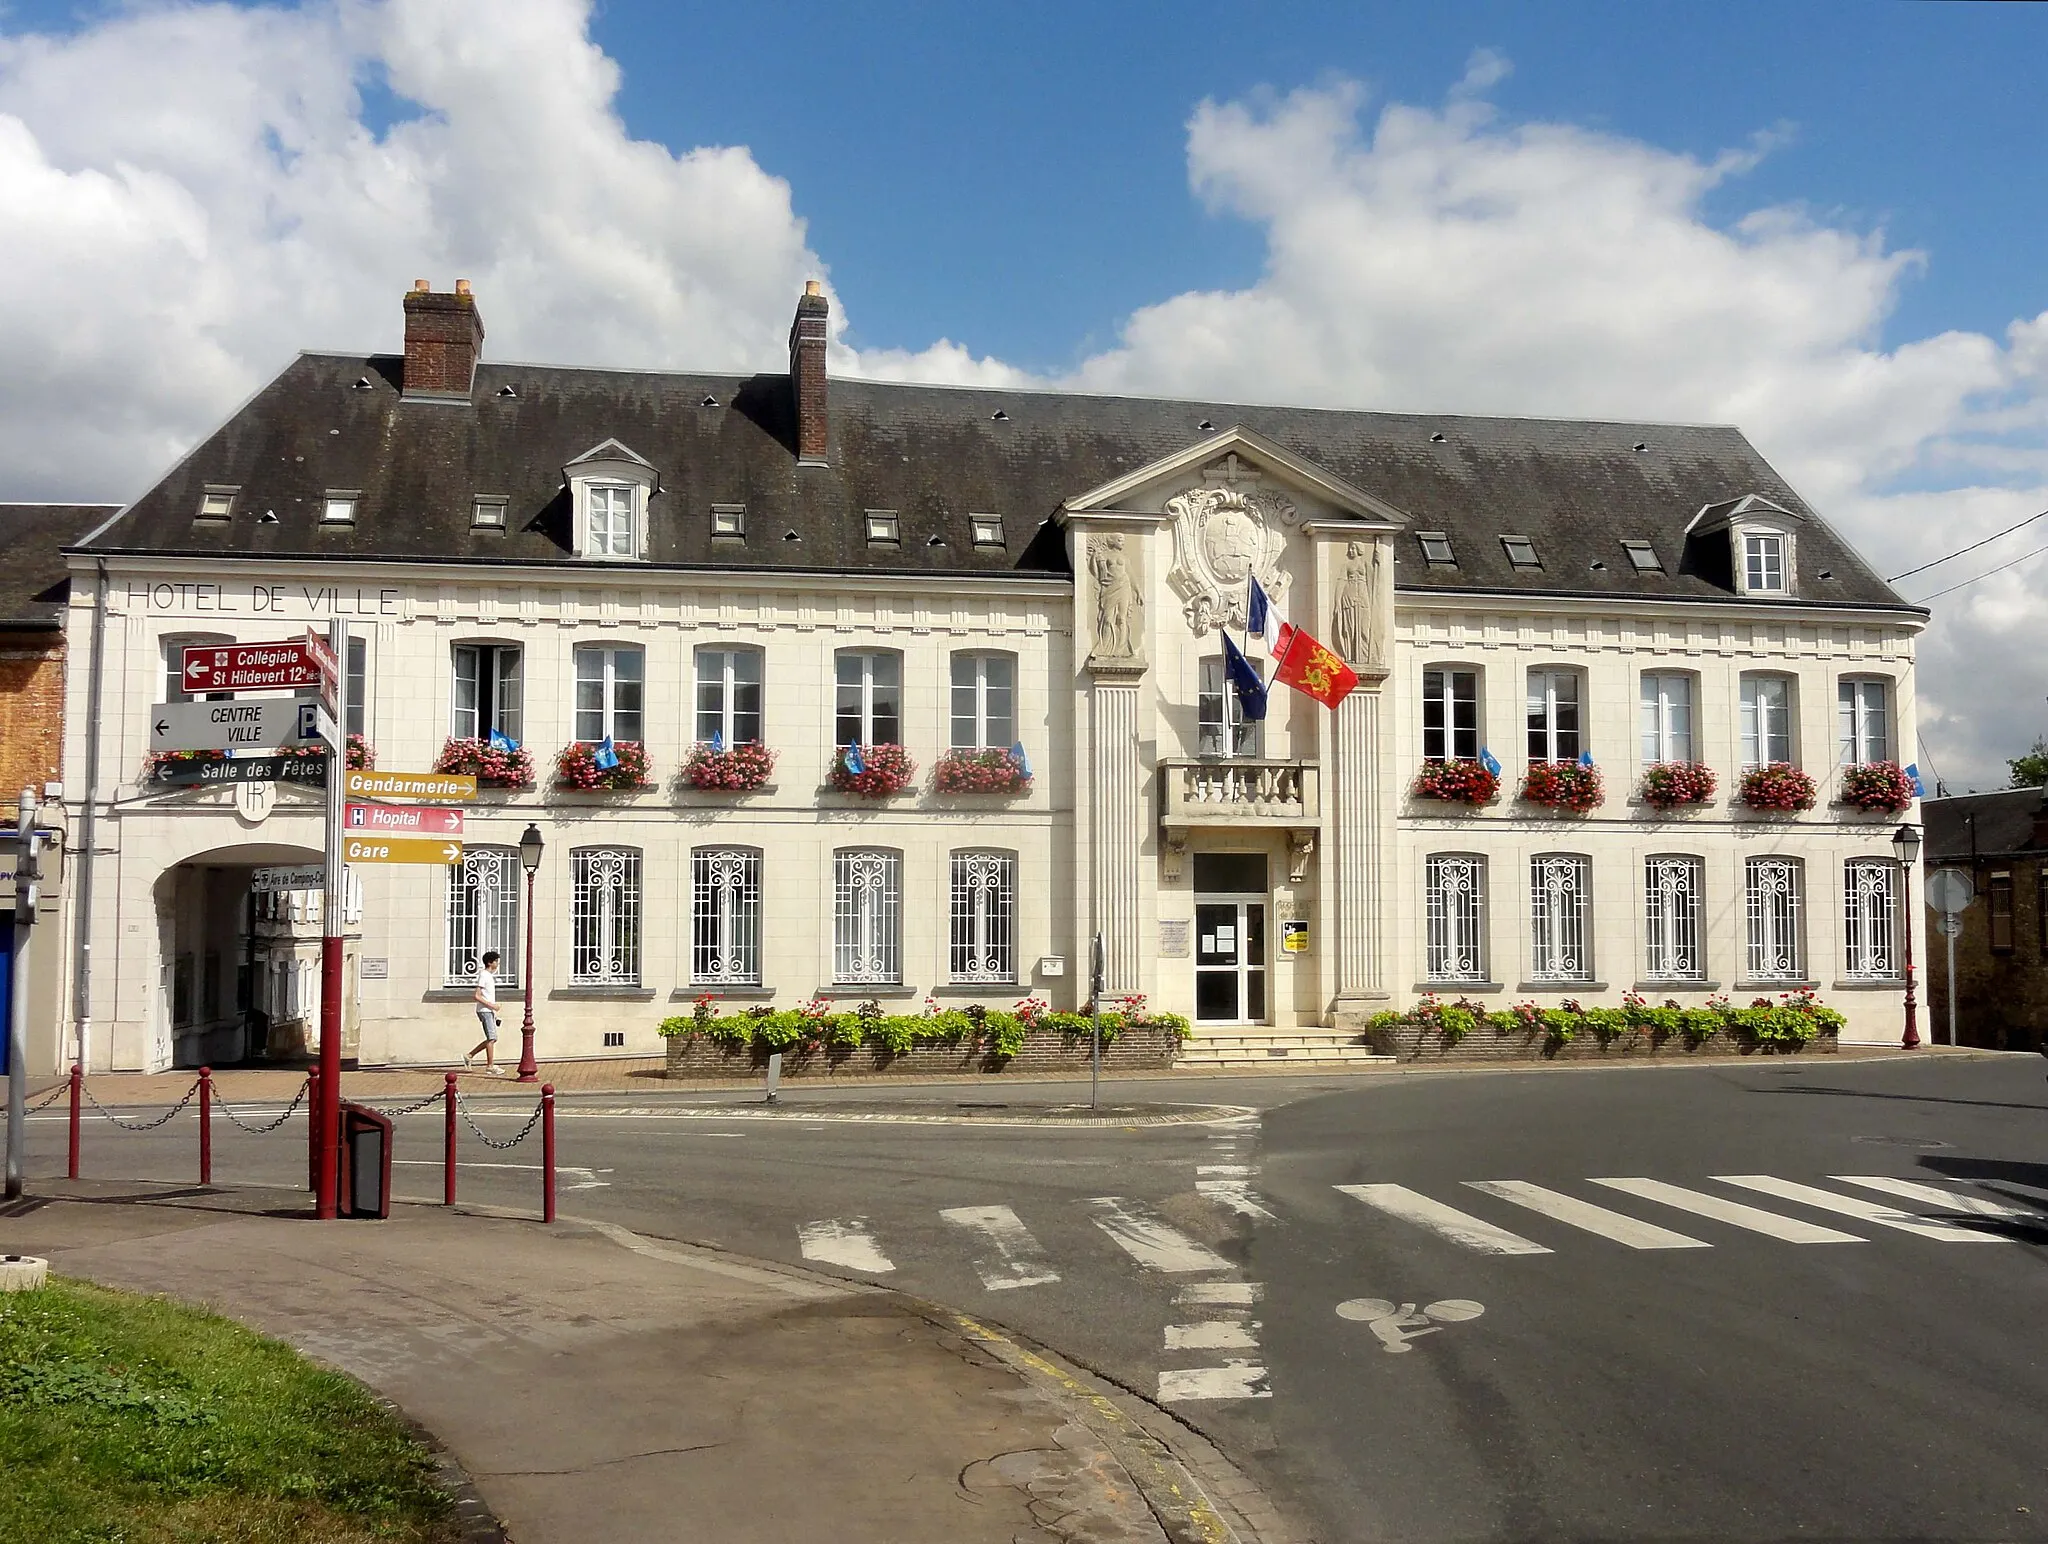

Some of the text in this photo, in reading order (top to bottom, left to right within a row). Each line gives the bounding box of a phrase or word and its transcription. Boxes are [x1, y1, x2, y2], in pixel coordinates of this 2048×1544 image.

[127, 583, 398, 615] HOTEL DE VILLE
[237, 649, 299, 667] Collégiale
[212, 671, 226, 685] St
[231, 669, 285, 685] Hildevert
[211, 706, 262, 723] CENTRE
[301, 708, 318, 736] P
[228, 726, 262, 742] VILLE
[201, 760, 323, 779] Salle des Fêtes
[350, 775, 458, 795] Gendarmerie
[353, 809, 422, 828] H Hopital
[350, 842, 389, 858] Gare
